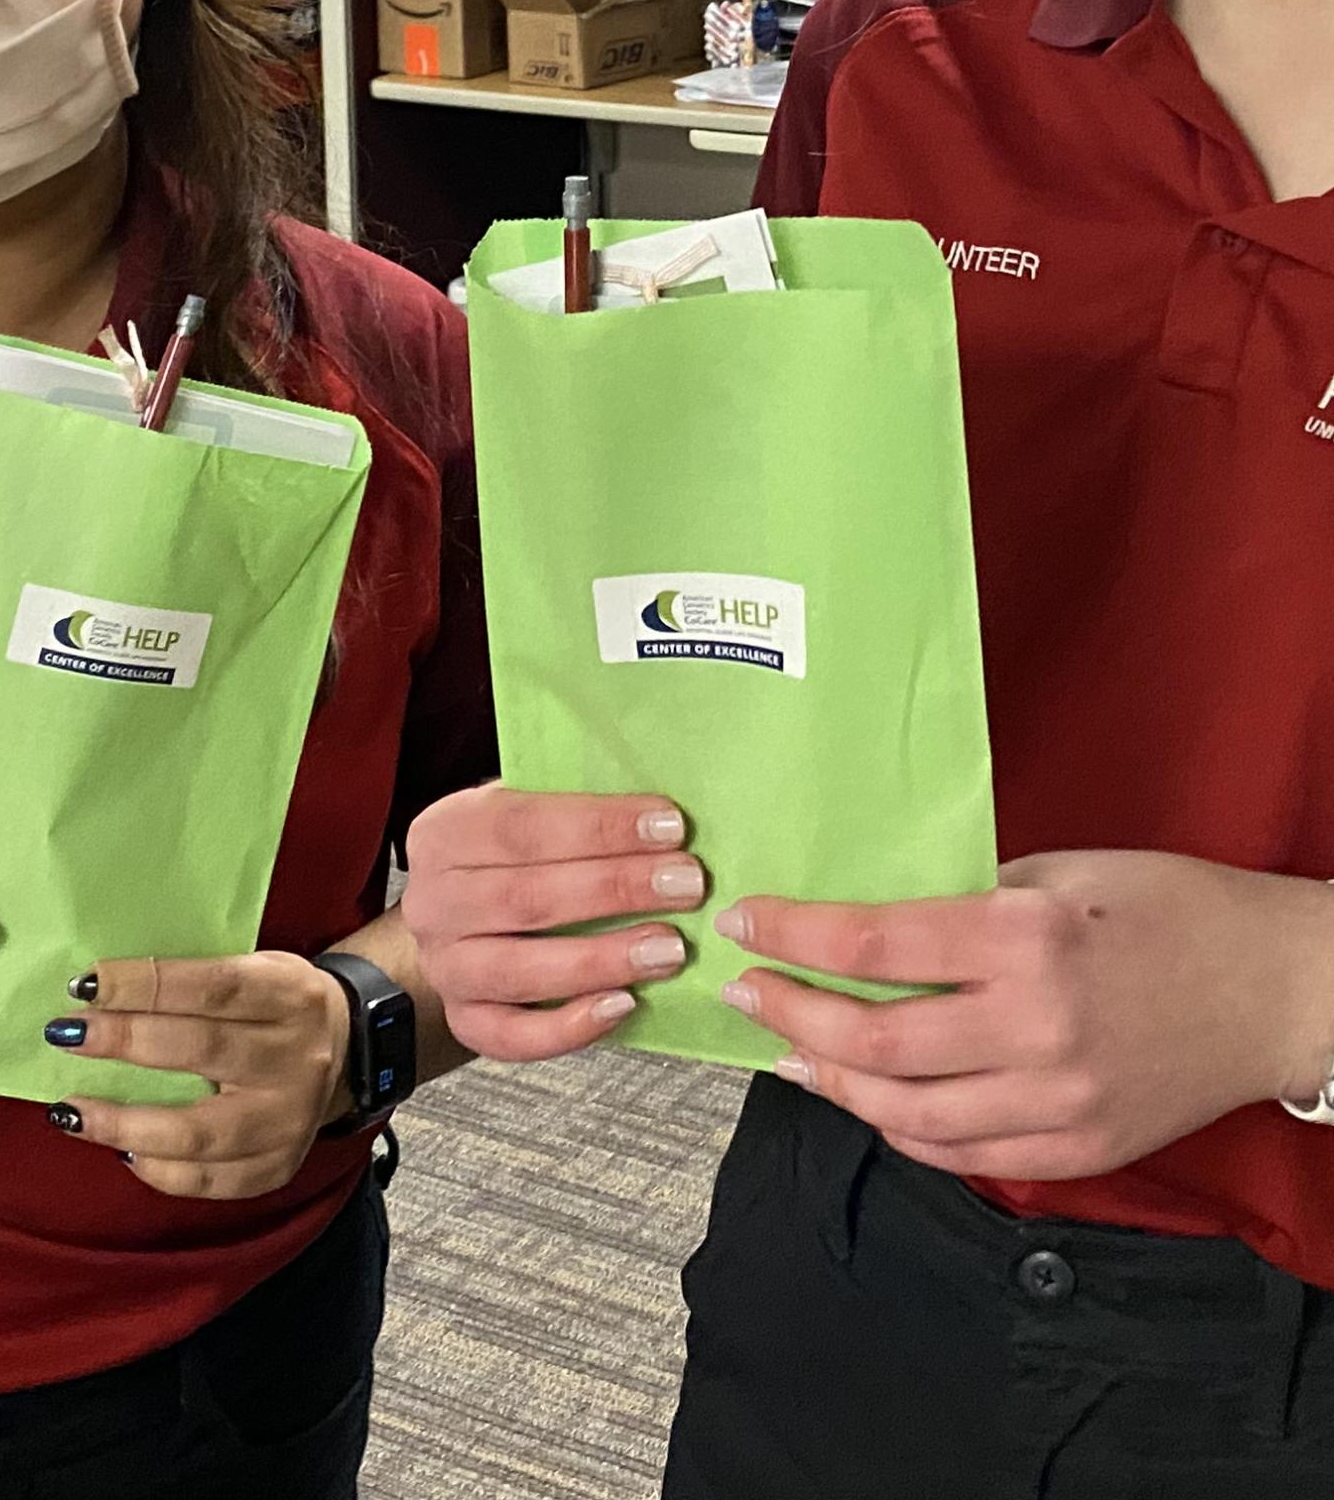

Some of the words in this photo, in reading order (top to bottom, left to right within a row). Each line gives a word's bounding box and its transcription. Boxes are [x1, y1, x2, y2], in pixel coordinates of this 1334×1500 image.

[719, 598, 779, 629] HELP
[123, 625, 181, 653] HELP
[44, 652, 86, 671] CENTER
[88, 662, 105, 674] OF
[107, 666, 170, 682] EXCELLENCE
[643, 642, 691, 655] CENTER
[696, 643, 711, 655] OF
[714, 644, 780, 667] EXCELLENCE
